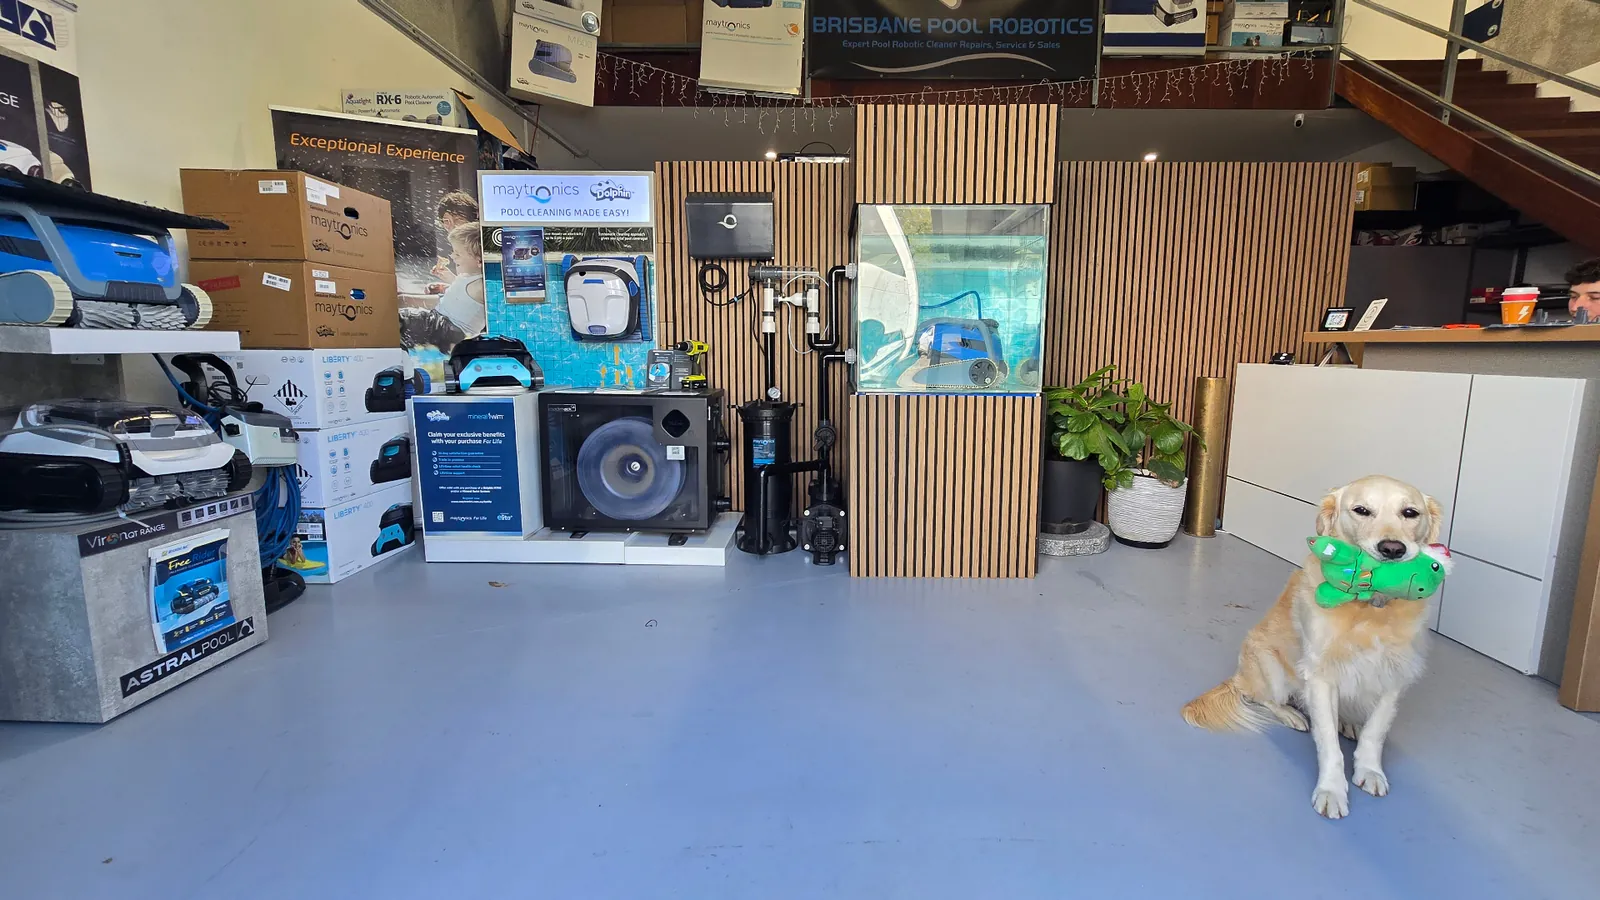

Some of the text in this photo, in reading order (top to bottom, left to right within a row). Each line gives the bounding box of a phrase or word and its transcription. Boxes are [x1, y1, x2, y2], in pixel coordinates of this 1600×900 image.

[518, 21, 549, 34] maytronics
[705, 19, 751, 32] maytronics
[812, 16, 1093, 35] BRISBANE POOL ROBOTICS
[842, 40, 1060, 50] Expert Pool Robotic Cleaner Repairs, Service & Sales
[376, 94, 402, 105] RX-6
[290, 133, 465, 164] Exceptional Experience
[493, 182, 632, 203] maytronics Dolphin
[500, 208, 629, 217] POOL CLEANING MADE EASY!
[311, 214, 368, 240] maytronics
[315, 302, 373, 321] maytronics
[322, 355, 350, 363] LIBERTY
[327, 431, 356, 443] LIBERTY
[333, 505, 361, 520] LIBERTY
[139, 523, 165, 536] RANGE
[168, 558, 192, 571] Free
[192, 548, 216, 562] Rider
[126, 631, 235, 692] ASTRALPOOL
